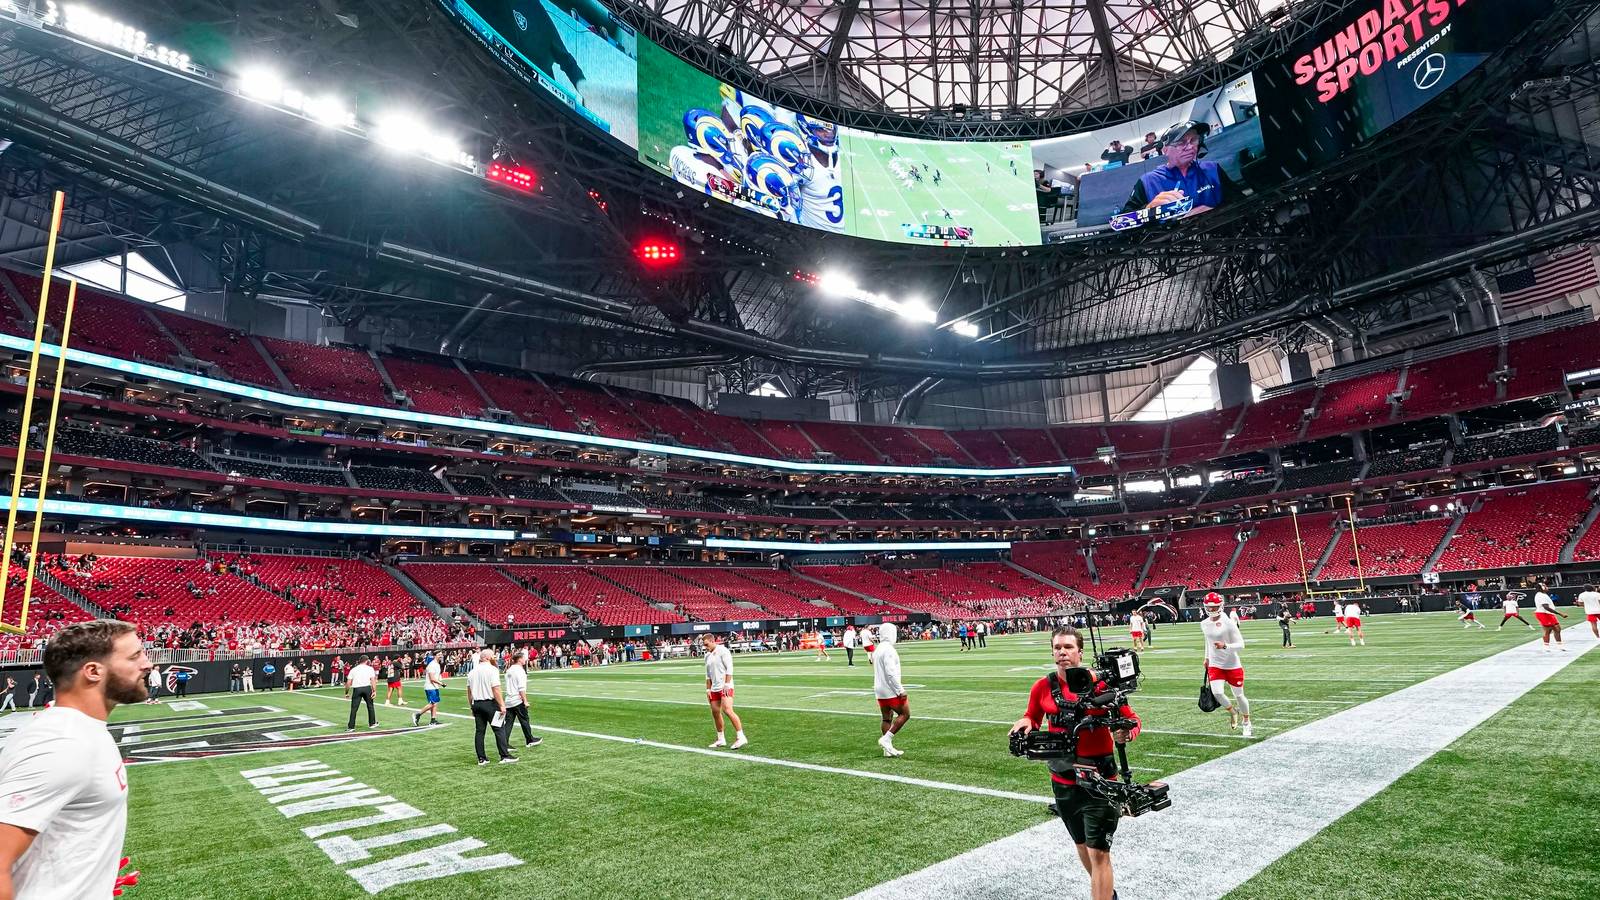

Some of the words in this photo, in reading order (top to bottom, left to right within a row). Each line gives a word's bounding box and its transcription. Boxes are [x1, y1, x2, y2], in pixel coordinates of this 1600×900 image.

[1293, 0, 1425, 86] SUNDA
[1316, 0, 1467, 104] SPORTS
[1397, 33, 1440, 69] PRESENTED
[1441, 23, 1452, 37] BY
[531, 69, 538, 79] 7
[747, 188, 756, 199] 14
[825, 185, 844, 224] 3
[1155, 206, 1162, 216] 6
[881, 615, 897, 623] RISE
[898, 614, 908, 622] UP
[513, 630, 546, 640] RISE
[548, 629, 566, 639] UP
[240, 760, 525, 895] ATLANTA
